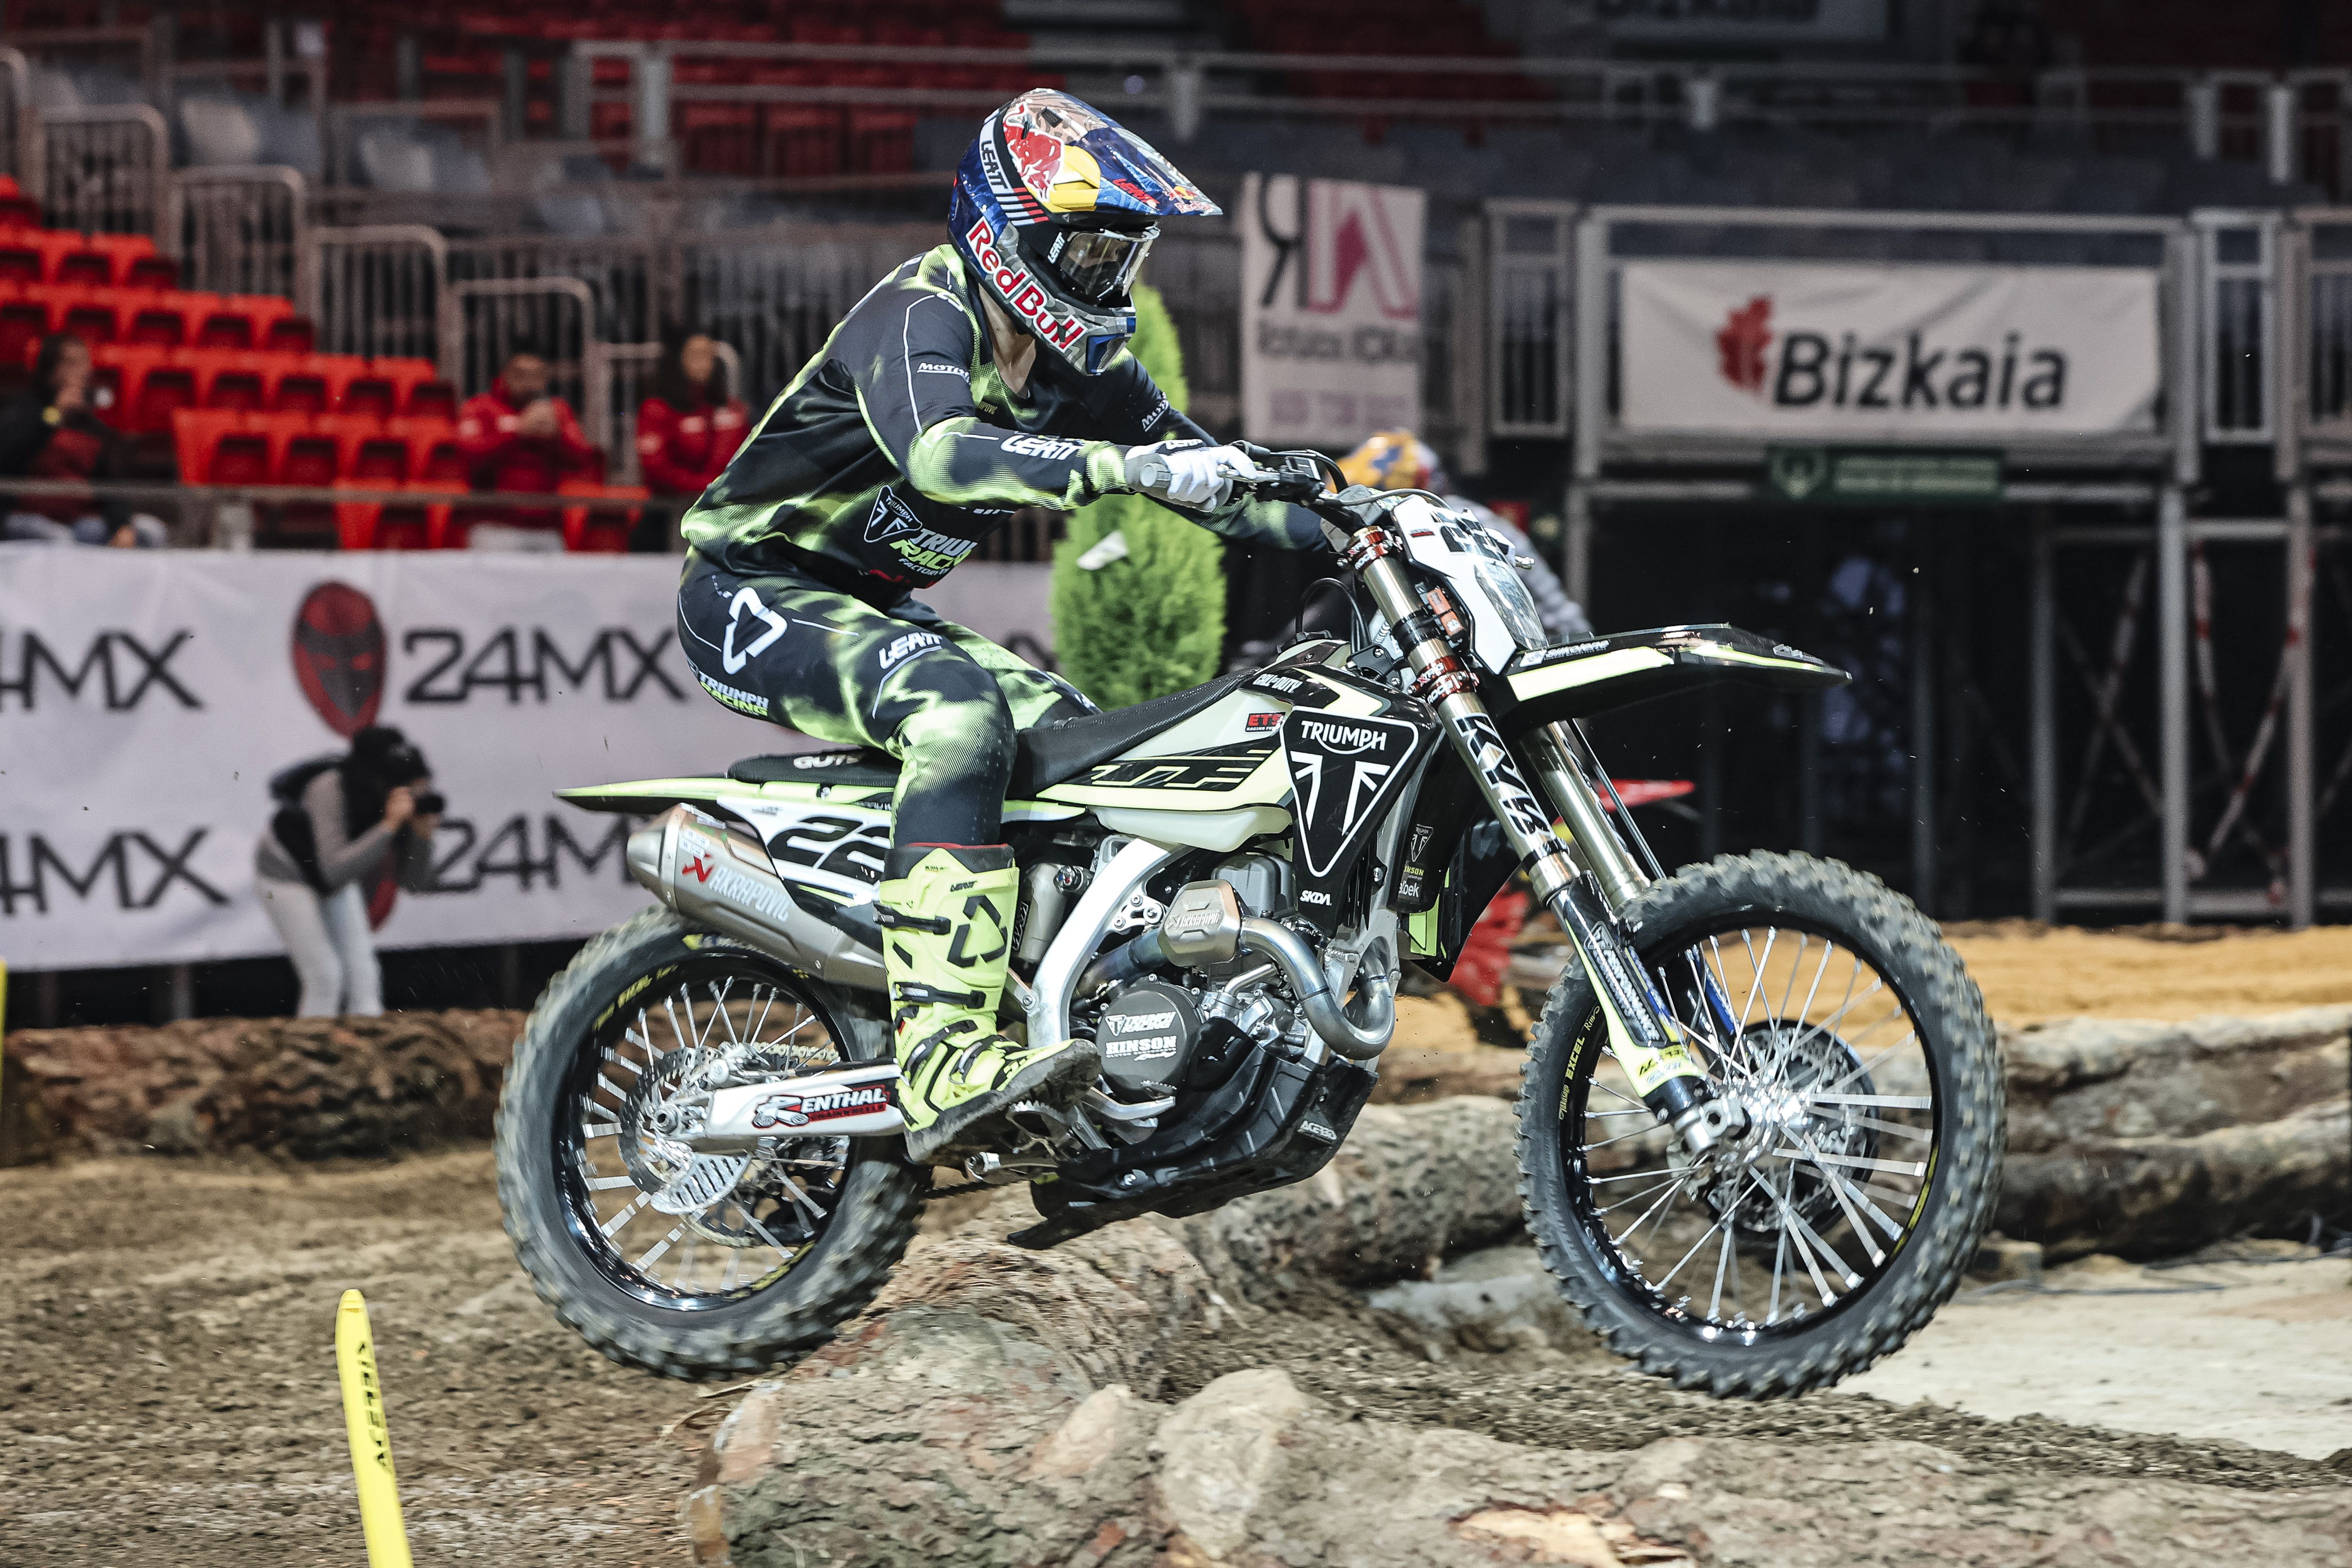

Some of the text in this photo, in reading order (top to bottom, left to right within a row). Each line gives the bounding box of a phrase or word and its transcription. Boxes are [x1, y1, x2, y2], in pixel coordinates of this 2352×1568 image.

[980, 140, 1009, 189] LEATT
[967, 216, 1030, 298] Red
[1048, 232, 1065, 264] LEATT
[1772, 330, 2067, 410] Bizkaia
[1001, 435, 1082, 460] LEATT
[885, 494, 913, 523] TRIUMPH
[910, 528, 978, 557] TRIU
[402, 625, 689, 704] 24MX
[879, 632, 943, 669] LEATT
[699, 670, 769, 709] TRIUMPH
[1252, 674, 1278, 687] CALL
[1301, 720, 1387, 755] TRIUMPH
[1451, 712, 1554, 839] KYB
[434, 814, 654, 891] 24M
[1404, 866, 1424, 876] INSON
[1105, 1035, 1177, 1055] HINSON
[1565, 1036, 1585, 1081] EXCEL
